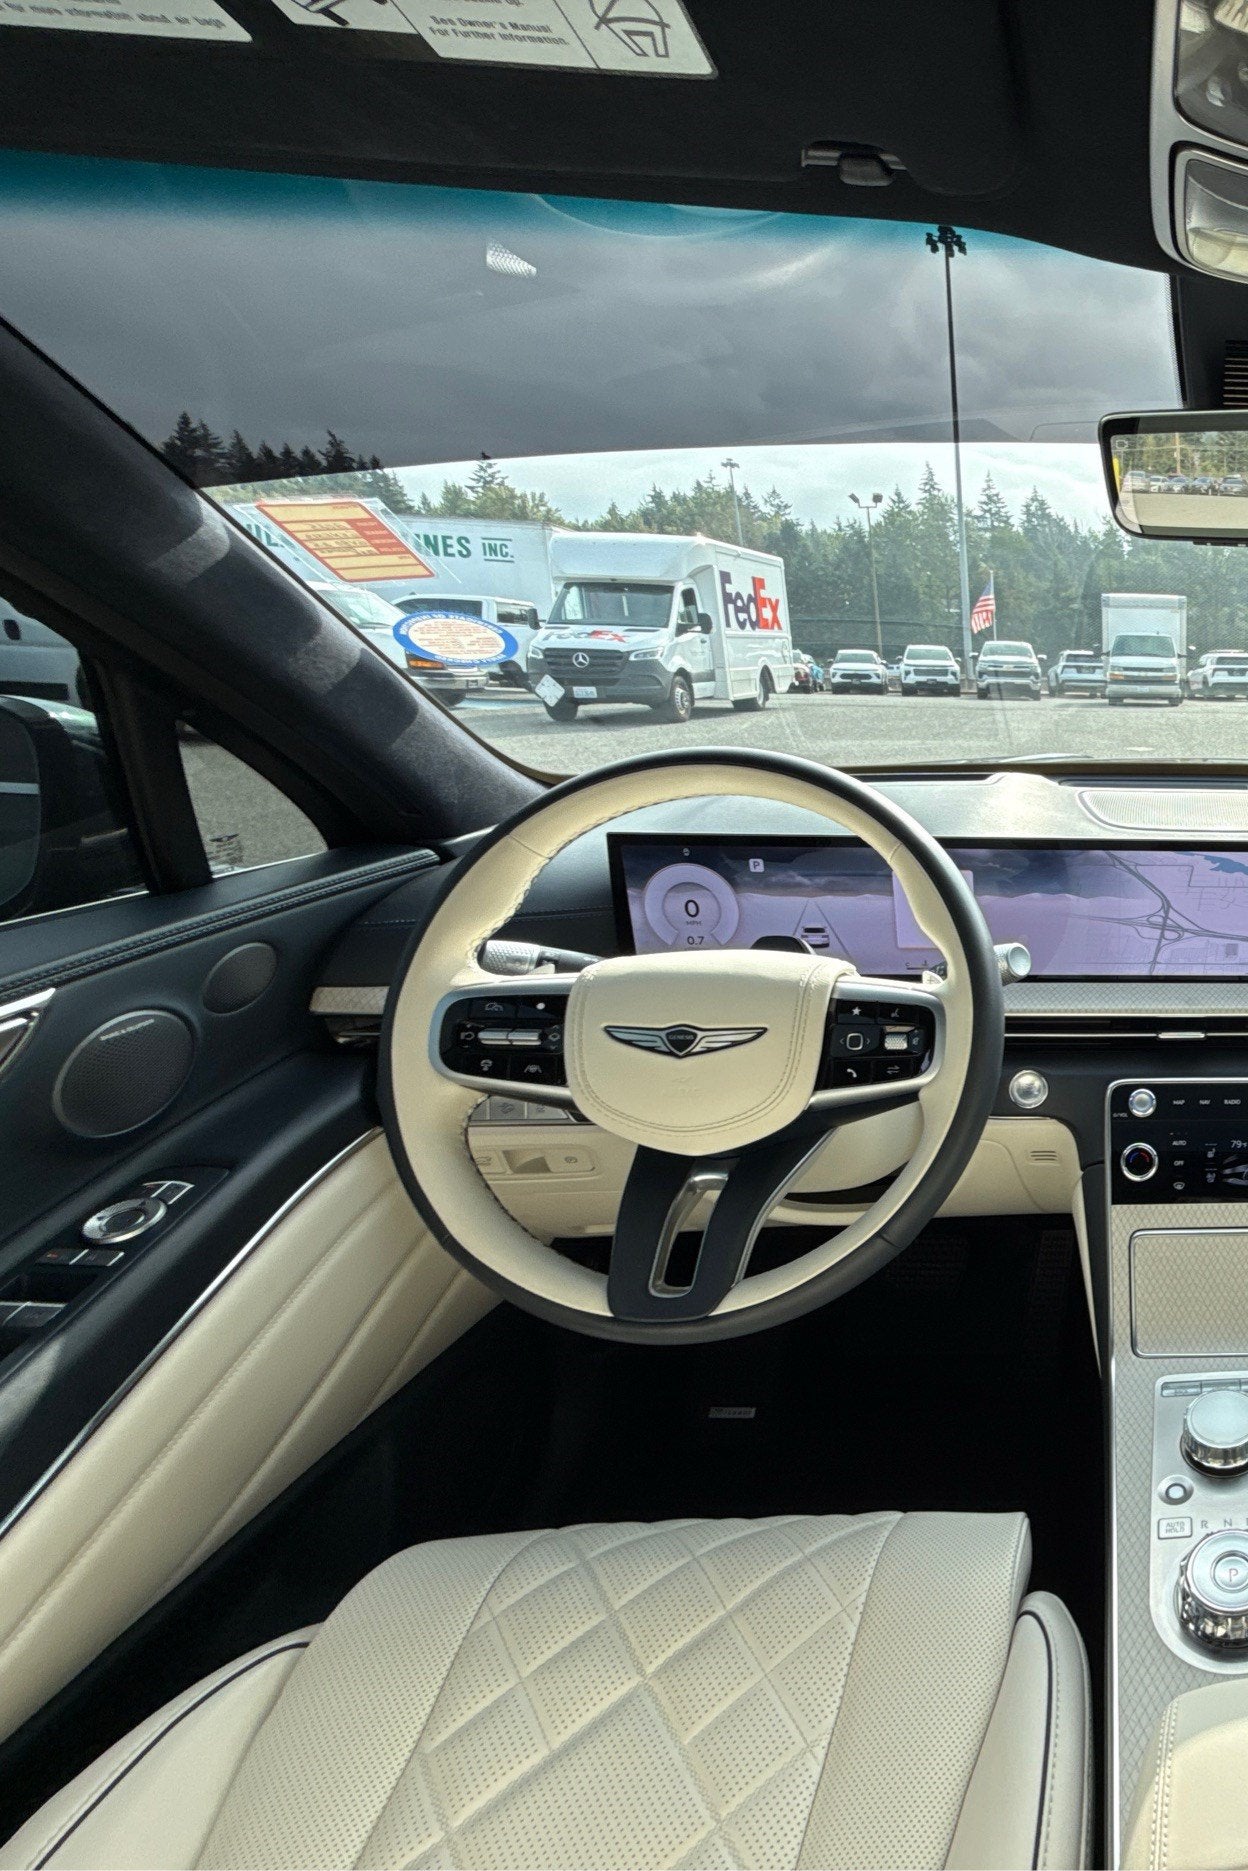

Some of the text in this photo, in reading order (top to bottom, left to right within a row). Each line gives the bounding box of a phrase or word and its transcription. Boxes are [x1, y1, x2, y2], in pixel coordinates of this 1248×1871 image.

[430, 15, 456, 26] See
[508, 21, 553, 34] Manual
[429, 27, 450, 36] For
[452, 28, 496, 41] Further
[414, 533, 472, 559] INES
[482, 542, 514, 558] INC.
[719, 570, 782, 631] FedEx
[753, 861, 760, 870] P
[684, 899, 700, 918] 0
[686, 936, 705, 946] 0.7
[1200, 1520, 1209, 1529] R
[1223, 1518, 1233, 1528] N
[1228, 1568, 1239, 1582] P
